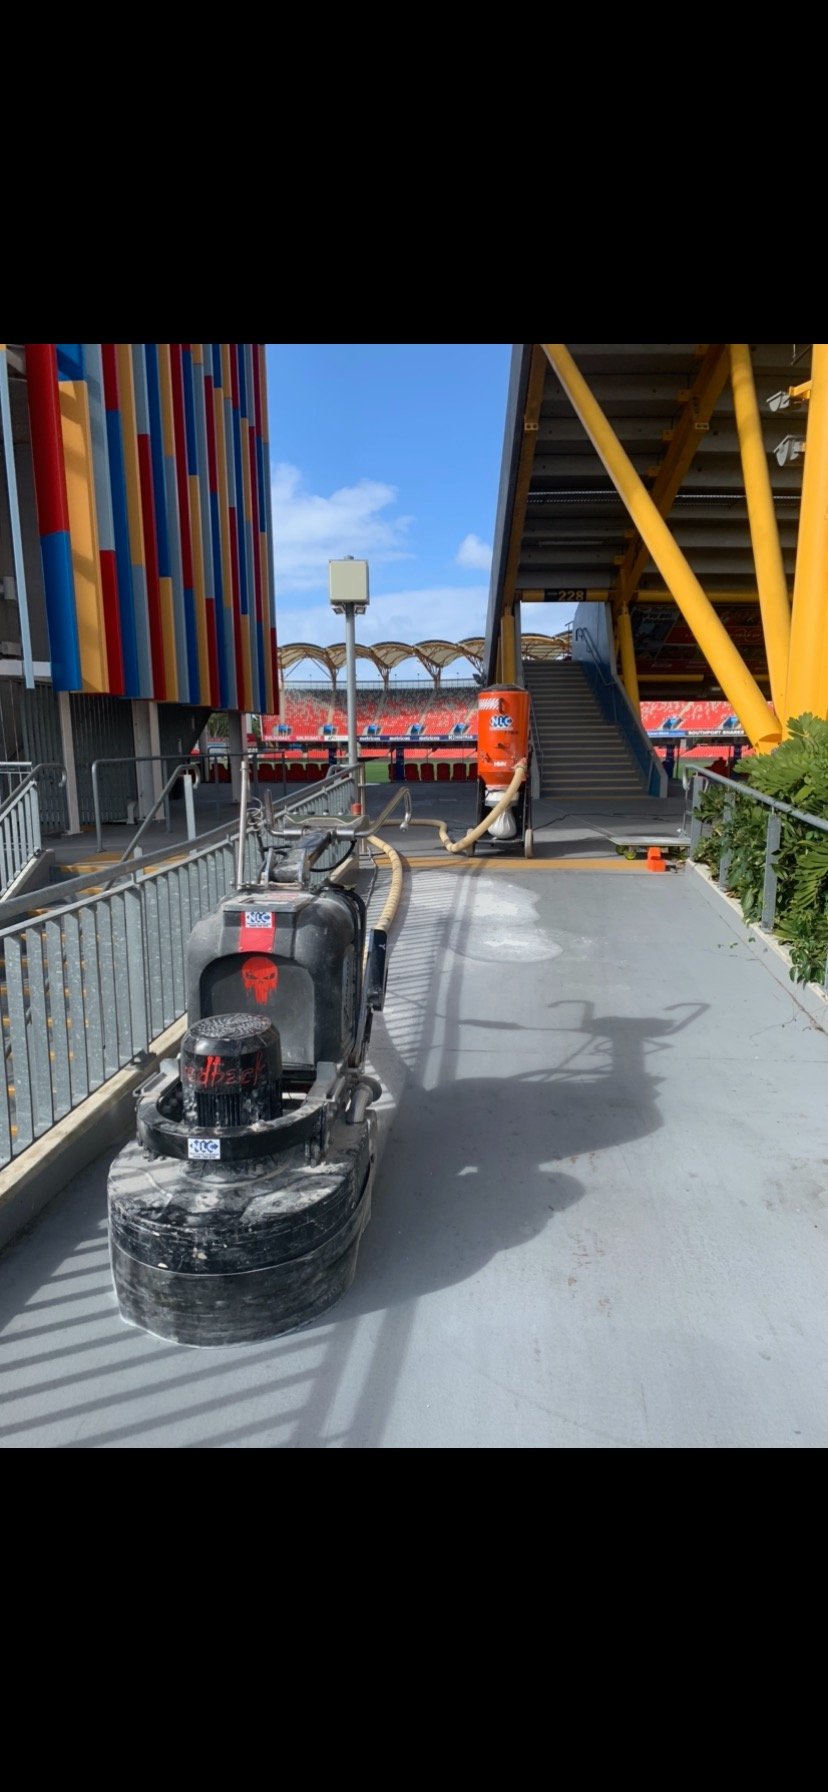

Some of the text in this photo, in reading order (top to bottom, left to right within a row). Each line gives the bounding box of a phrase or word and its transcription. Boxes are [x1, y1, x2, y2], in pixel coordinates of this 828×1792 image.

[559, 590, 584, 601] 228
[491, 715, 512, 727] NLC
[248, 911, 271, 923] NLC
[191, 1140, 217, 1153] NLC
